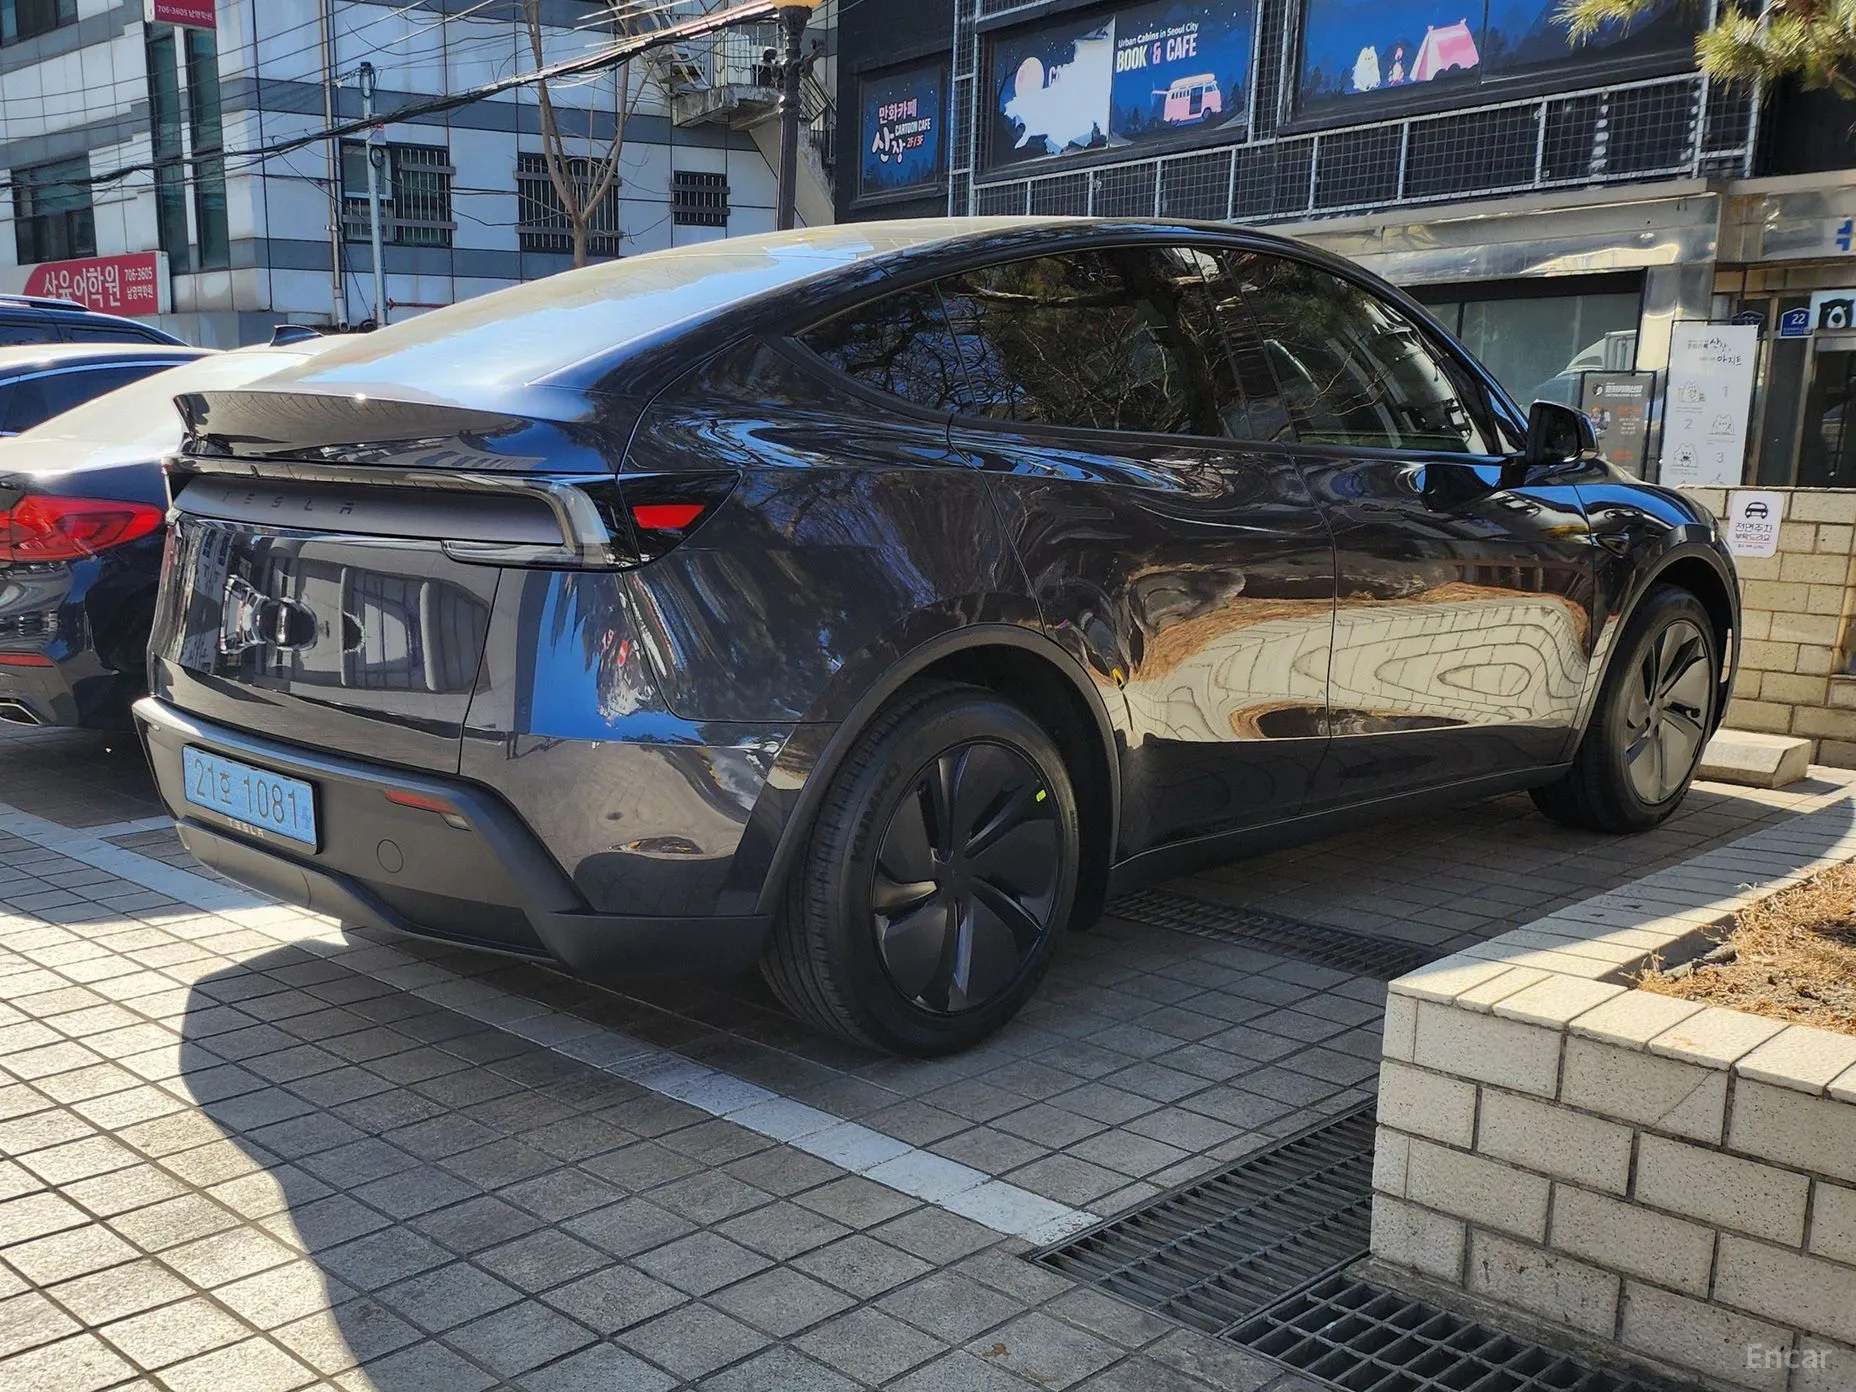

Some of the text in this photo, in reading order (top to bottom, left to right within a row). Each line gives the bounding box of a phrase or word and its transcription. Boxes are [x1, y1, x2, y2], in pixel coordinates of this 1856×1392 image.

[1118, 21, 1199, 48] Urban Cabins in Seoul City
[1116, 33, 1198, 73] BOOK & CAFE
[879, 98, 917, 124] 만화카페
[895, 118, 931, 137] CARTOON CAFE
[872, 127, 906, 163] 산장
[124, 267, 153, 281] 706-3605
[1791, 313, 1806, 325] 22
[1716, 355, 1742, 366] 아지트
[1723, 386, 1729, 397] 1
[1684, 419, 1694, 430] 2
[1716, 452, 1725, 463] 3
[222, 491, 355, 515] TESLA
[1735, 522, 1772, 533] 전면주차
[194, 759, 298, 829] 21호 1081
[227, 818, 264, 838] TESLA
